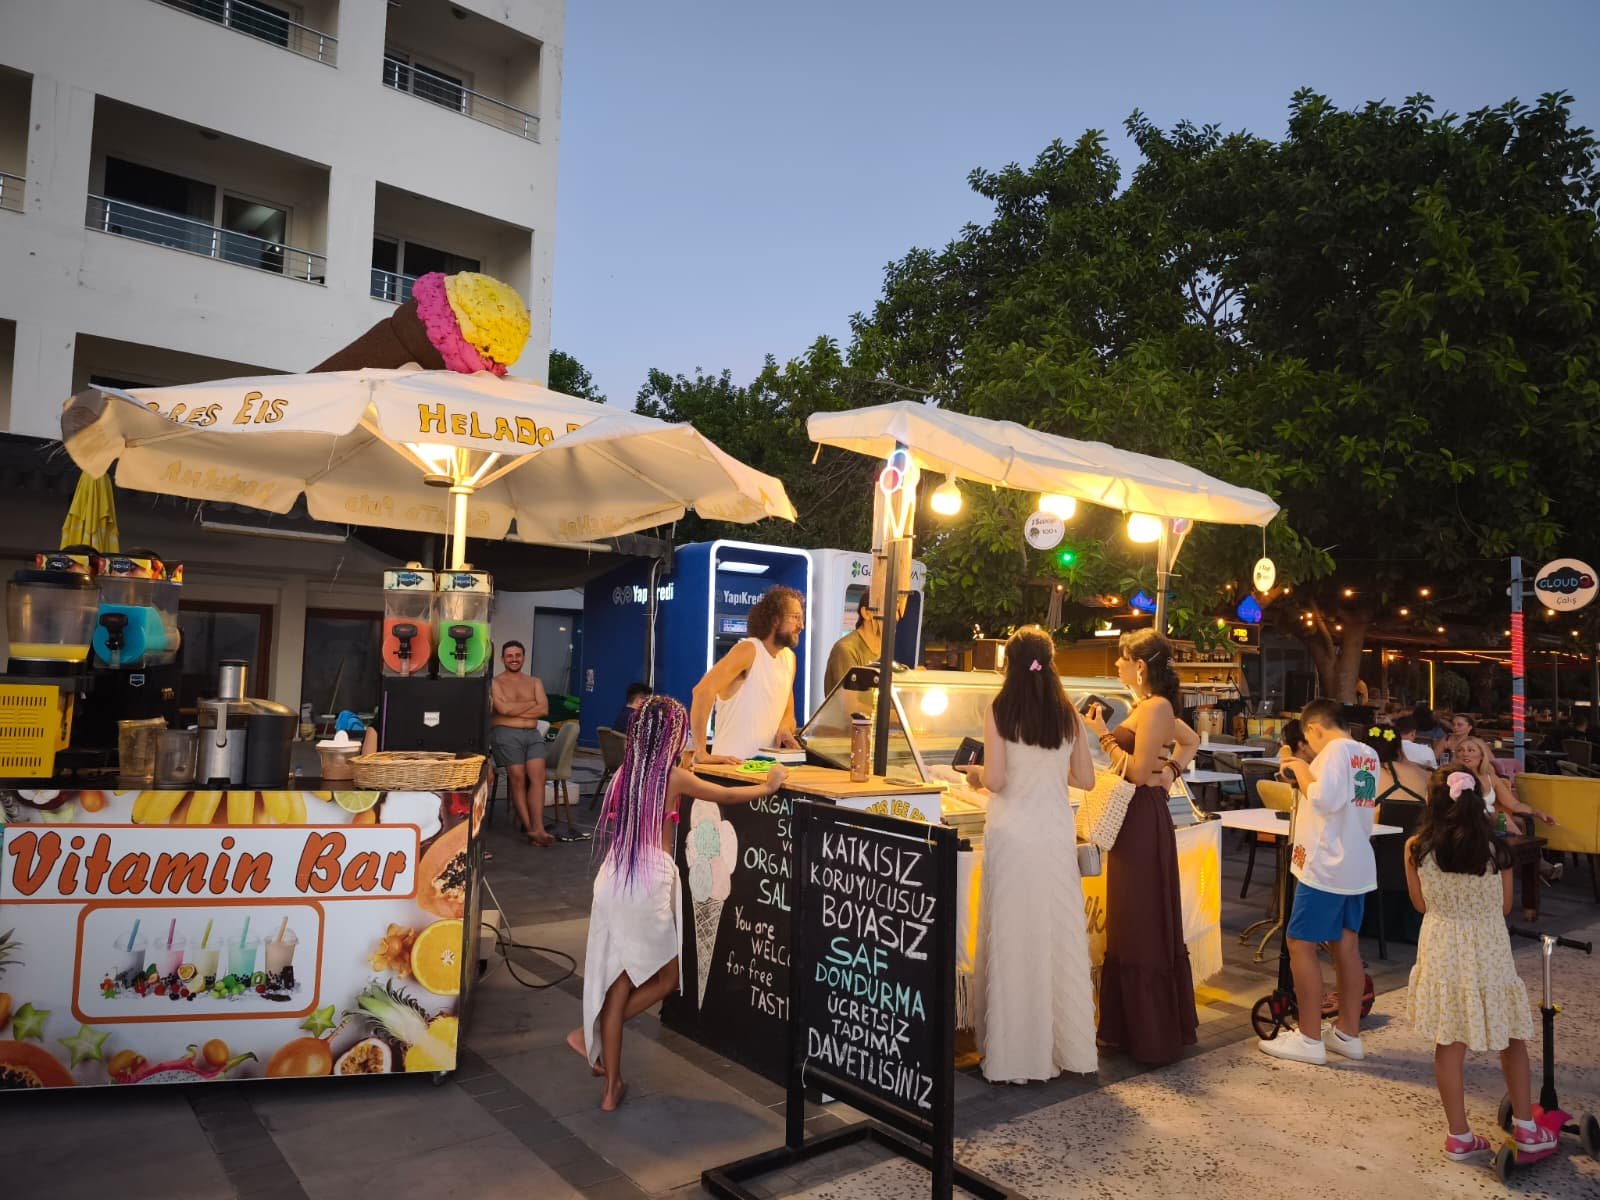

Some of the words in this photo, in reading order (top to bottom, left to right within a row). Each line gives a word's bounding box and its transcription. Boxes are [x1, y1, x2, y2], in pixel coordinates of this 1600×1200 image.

[632, 582, 675, 605] Yapredi
[8, 830, 274, 896] Vitamin
[295, 831, 407, 894] Bar
[744, 847, 792, 879] ORGA
[822, 831, 922, 887] KATKISIZ
[810, 862, 937, 923] KORUYUCUSUZ
[735, 905, 752, 931] You
[755, 921, 775, 940] are
[822, 894, 928, 960] BOYASIZ
[726, 950, 745, 975] for
[749, 958, 773, 987] free
[825, 936, 888, 976] SAF
[815, 962, 926, 1021] DONDURMA
[831, 1019, 902, 1059] TADIMA
